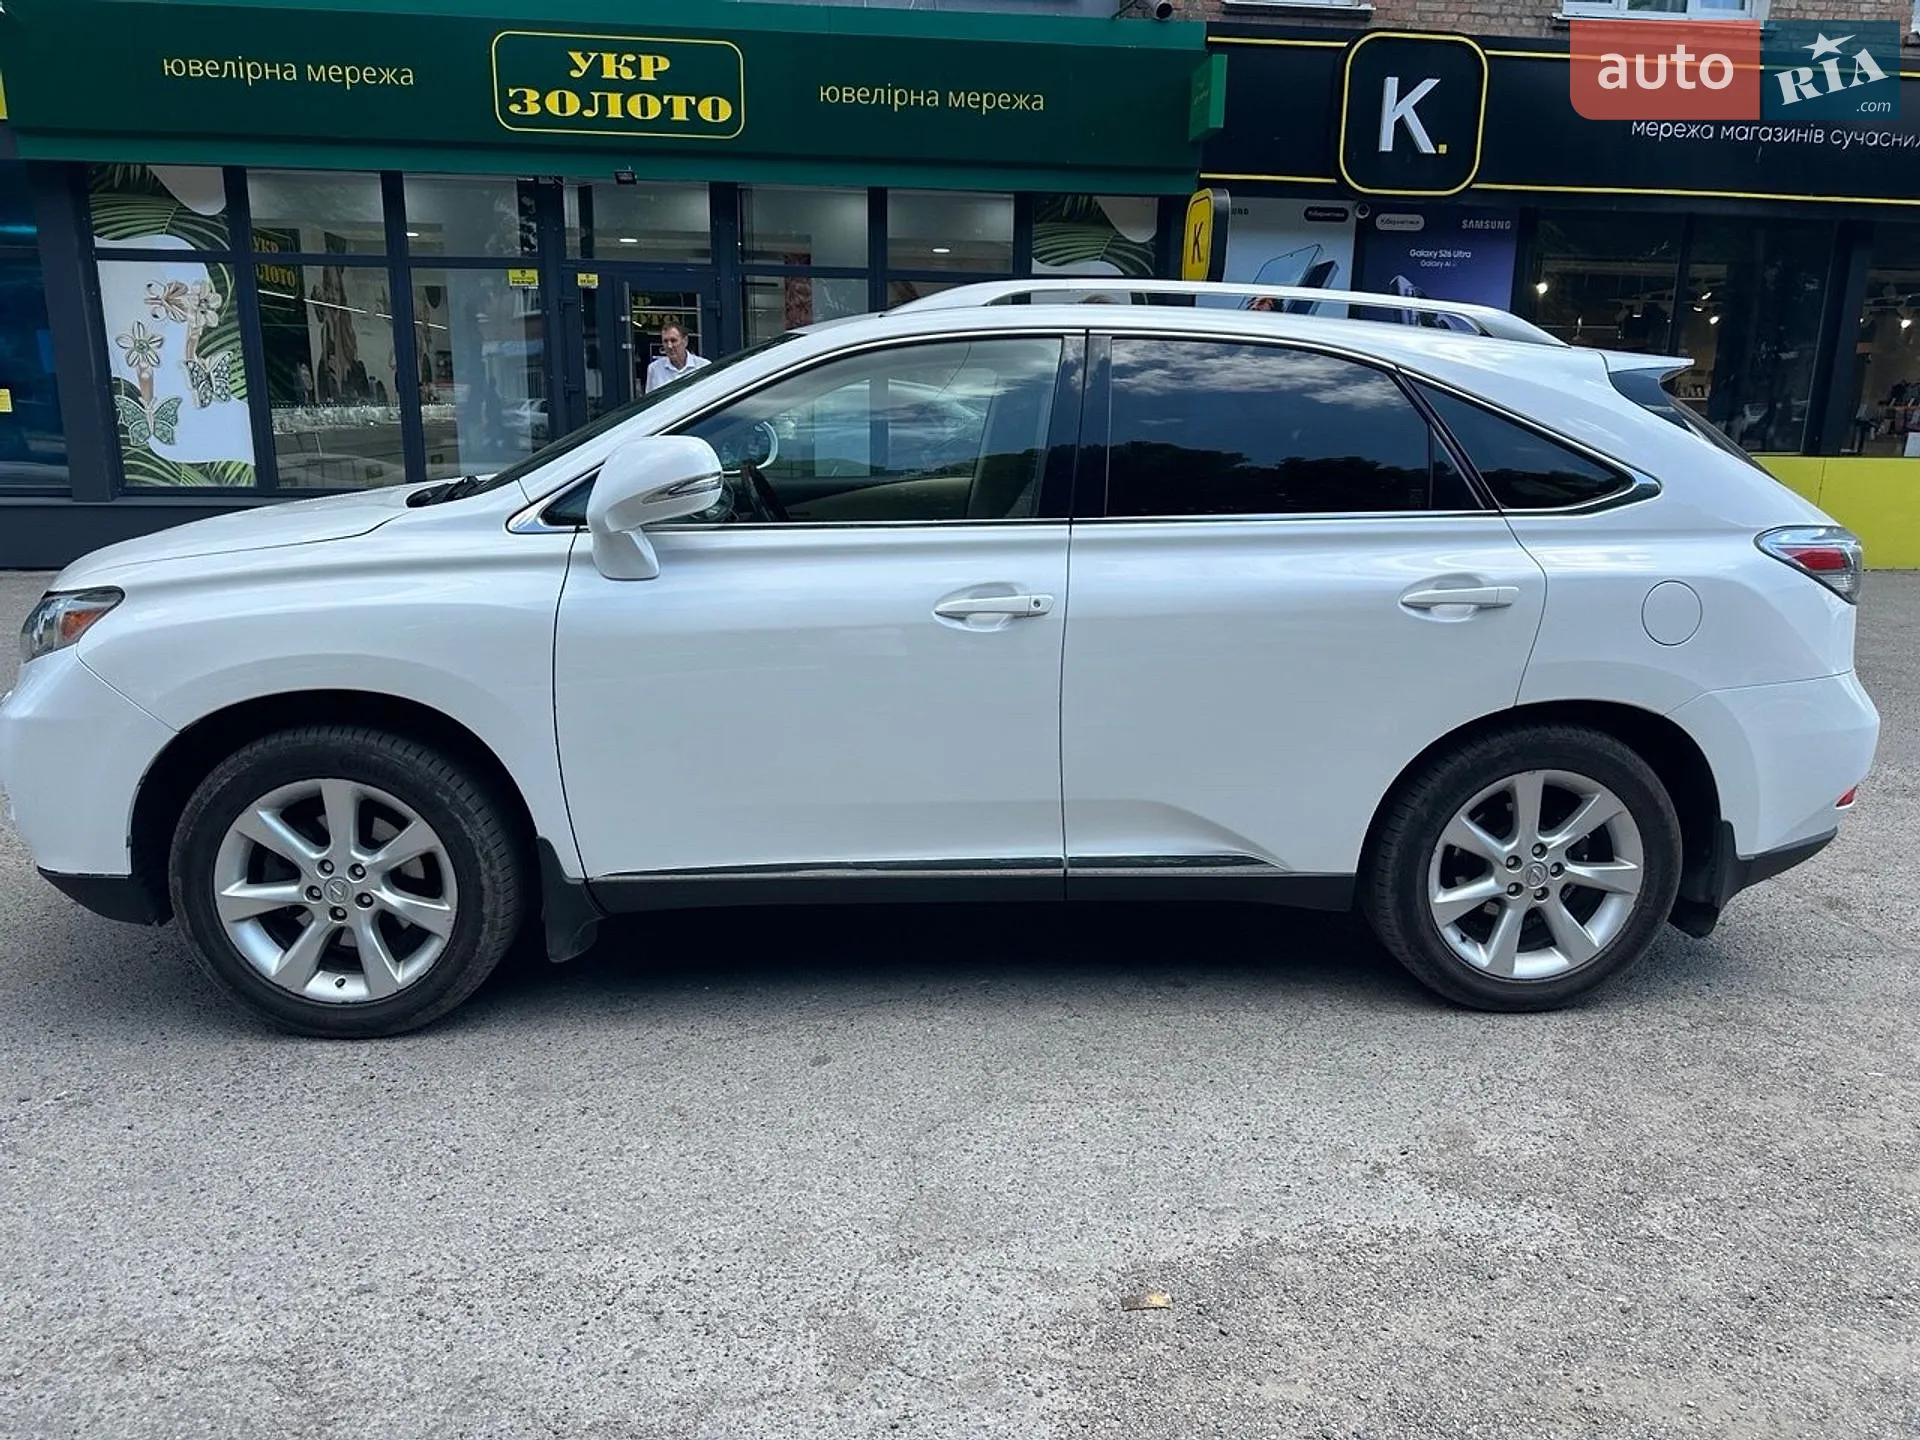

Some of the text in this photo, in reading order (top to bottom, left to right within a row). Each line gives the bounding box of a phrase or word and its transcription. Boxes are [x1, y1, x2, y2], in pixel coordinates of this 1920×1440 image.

[163, 56, 414, 90] ювелірна мережа
[568, 51, 670, 81] УКР
[508, 88, 733, 123] ЗОЛОТО
[819, 83, 1044, 115] ювелірна мережа
[1631, 120, 1715, 142] мережа
[1720, 123, 1824, 144] магазинів
[1461, 219, 1512, 230] SAMSUNG
[1409, 249, 1438, 259] Galaxy
